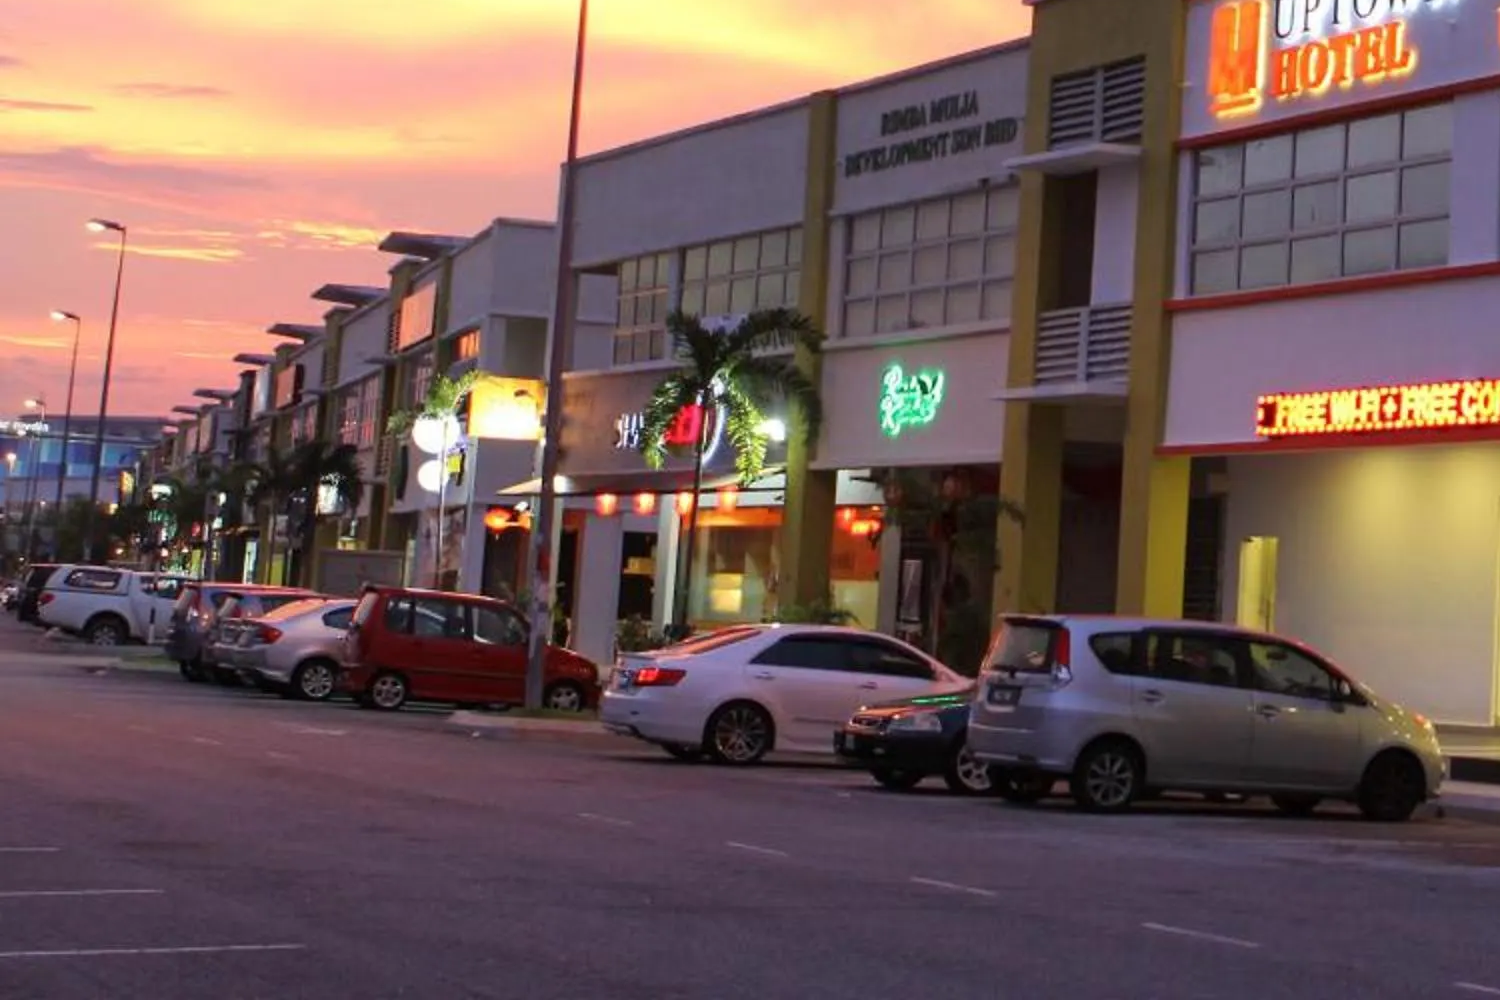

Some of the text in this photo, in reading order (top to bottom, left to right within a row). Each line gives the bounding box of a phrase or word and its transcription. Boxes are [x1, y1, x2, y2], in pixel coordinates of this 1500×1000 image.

[1270, 20, 1412, 99] HOTEL
[1275, 394, 1327, 426] FREE
[1402, 385, 1458, 420] FREE
